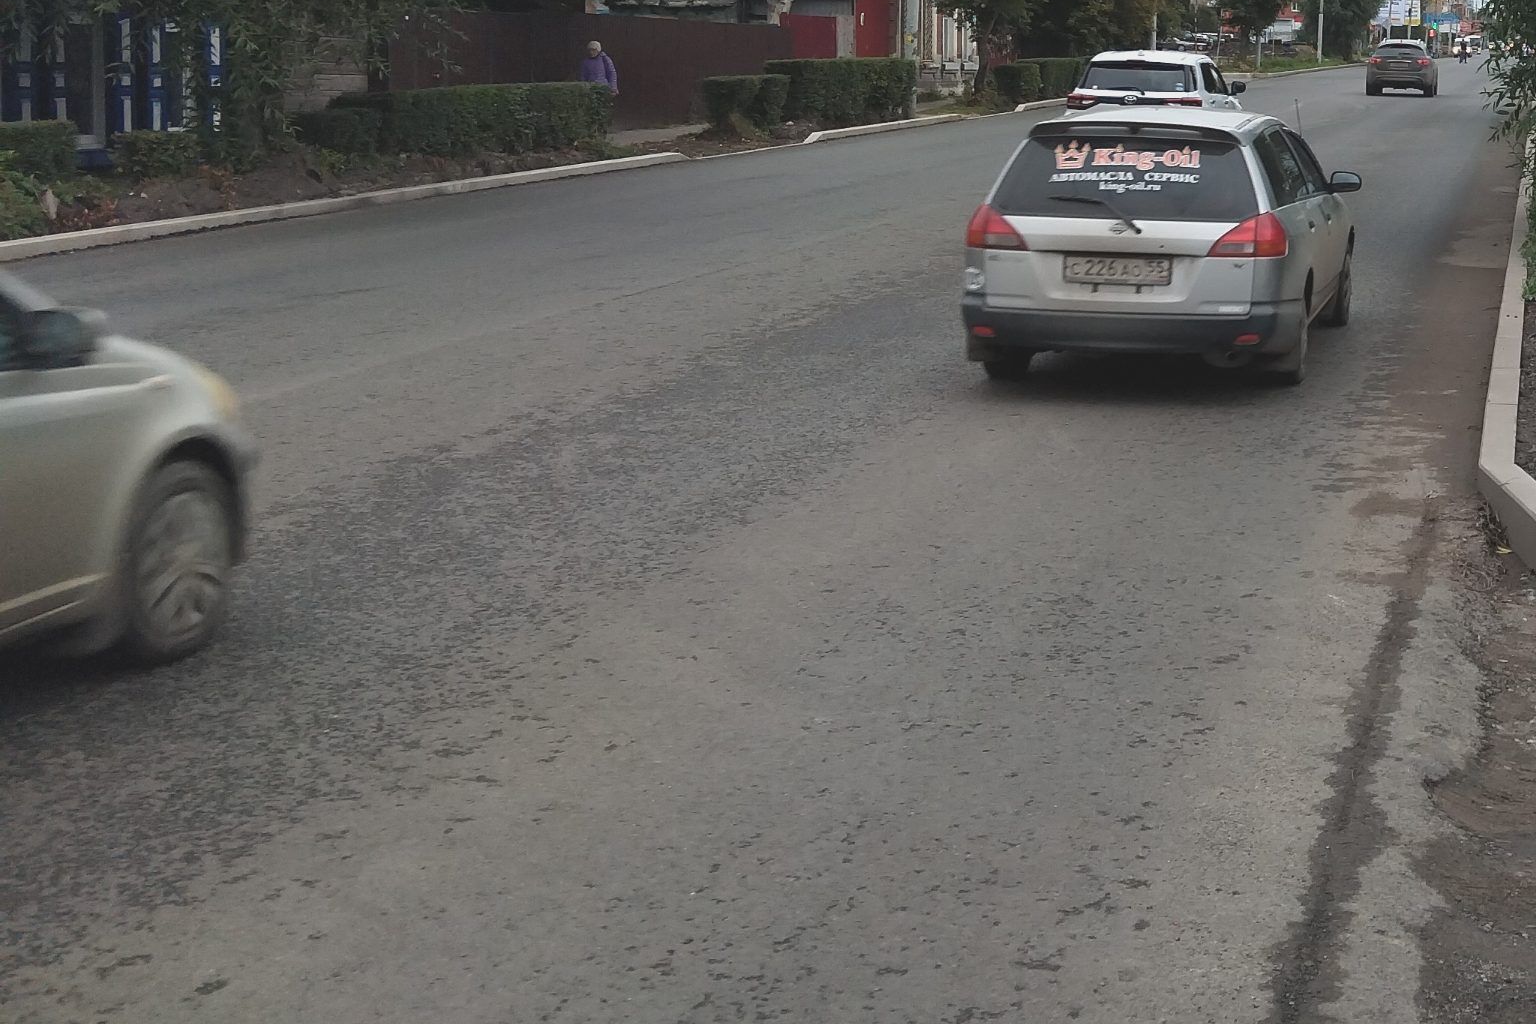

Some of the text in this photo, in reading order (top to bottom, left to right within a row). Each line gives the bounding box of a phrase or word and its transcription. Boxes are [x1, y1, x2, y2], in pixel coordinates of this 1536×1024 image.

[1091, 143, 1201, 170] King-Oil
[1049, 172, 1200, 184] АВТОМАСЛА СЕРВИС
